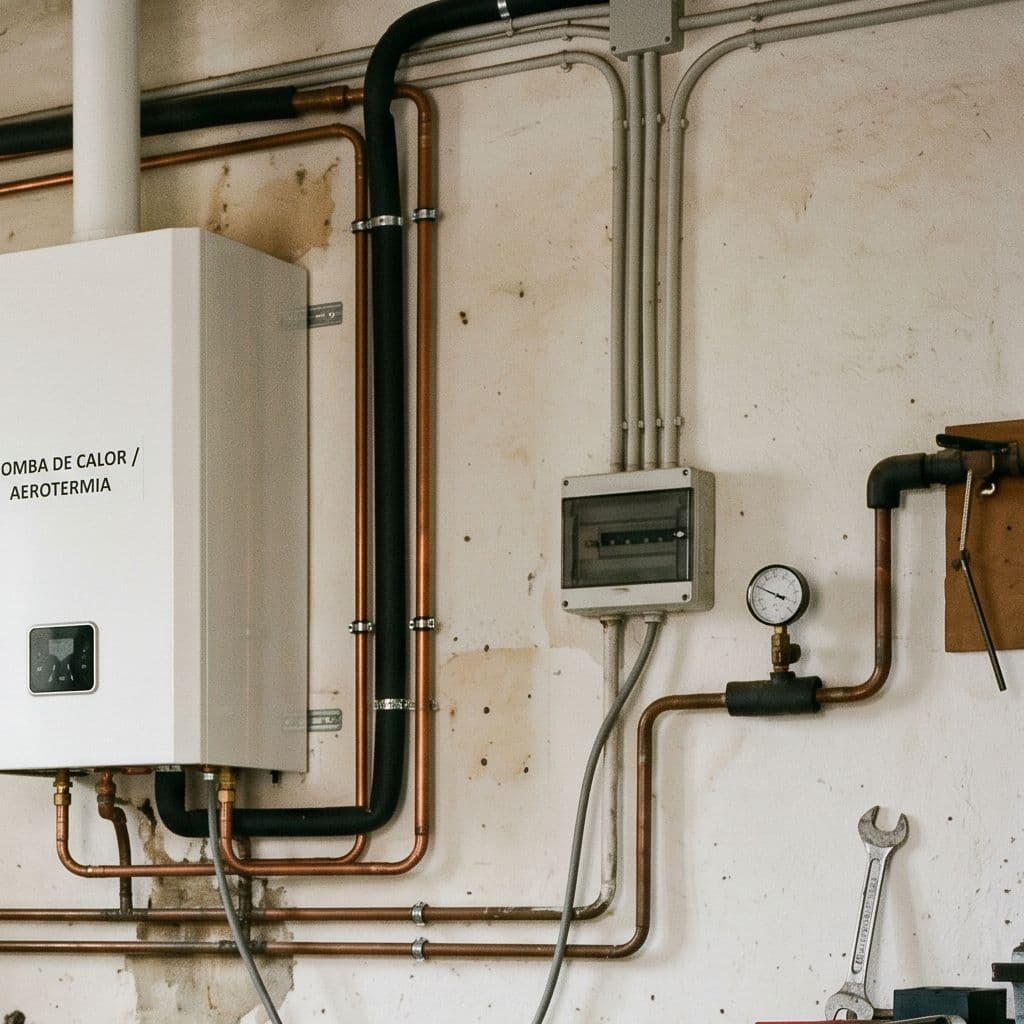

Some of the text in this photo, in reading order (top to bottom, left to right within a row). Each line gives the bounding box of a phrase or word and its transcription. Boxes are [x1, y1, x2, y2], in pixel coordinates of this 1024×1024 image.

[53, 455, 72, 471] DE
[76, 450, 127, 469] CALOR
[131, 447, 140, 467] /
[9, 477, 112, 500] AEROTERMIA
